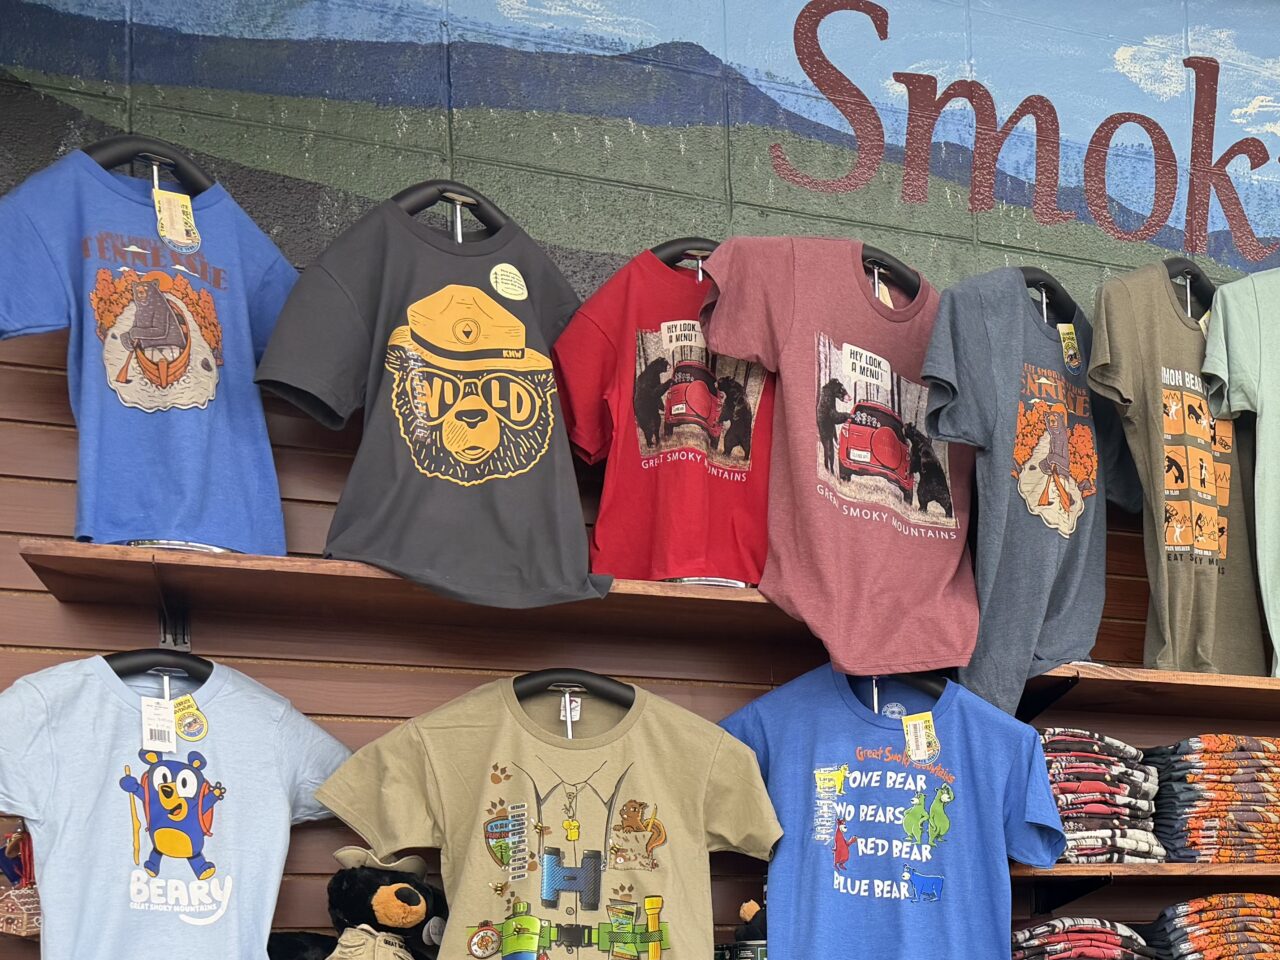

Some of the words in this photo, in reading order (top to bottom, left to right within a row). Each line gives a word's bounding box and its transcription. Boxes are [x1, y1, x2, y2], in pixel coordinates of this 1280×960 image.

[849, 348, 863, 364] HEY
[851, 362, 857, 373] A
[666, 451, 702, 463] SMOKY
[816, 484, 839, 509] GREA
[842, 504, 889, 523] SMOKY
[891, 516, 957, 540] MOUNTAINS
[855, 746, 883, 762] Great
[849, 770, 882, 789] ONE
[886, 773, 927, 792] BEAR
[833, 801, 855, 822] WO
[859, 804, 905, 825] BEARS
[857, 837, 889, 857] RED
[892, 839, 933, 863] BEAR
[833, 871, 870, 897] BLUE
[873, 879, 911, 900] BEAR
[129, 868, 233, 926] BEARY
[129, 902, 149, 910] GREAT
[150, 903, 172, 912] SMOKY
[173, 903, 217, 912] MOUNTAINS
